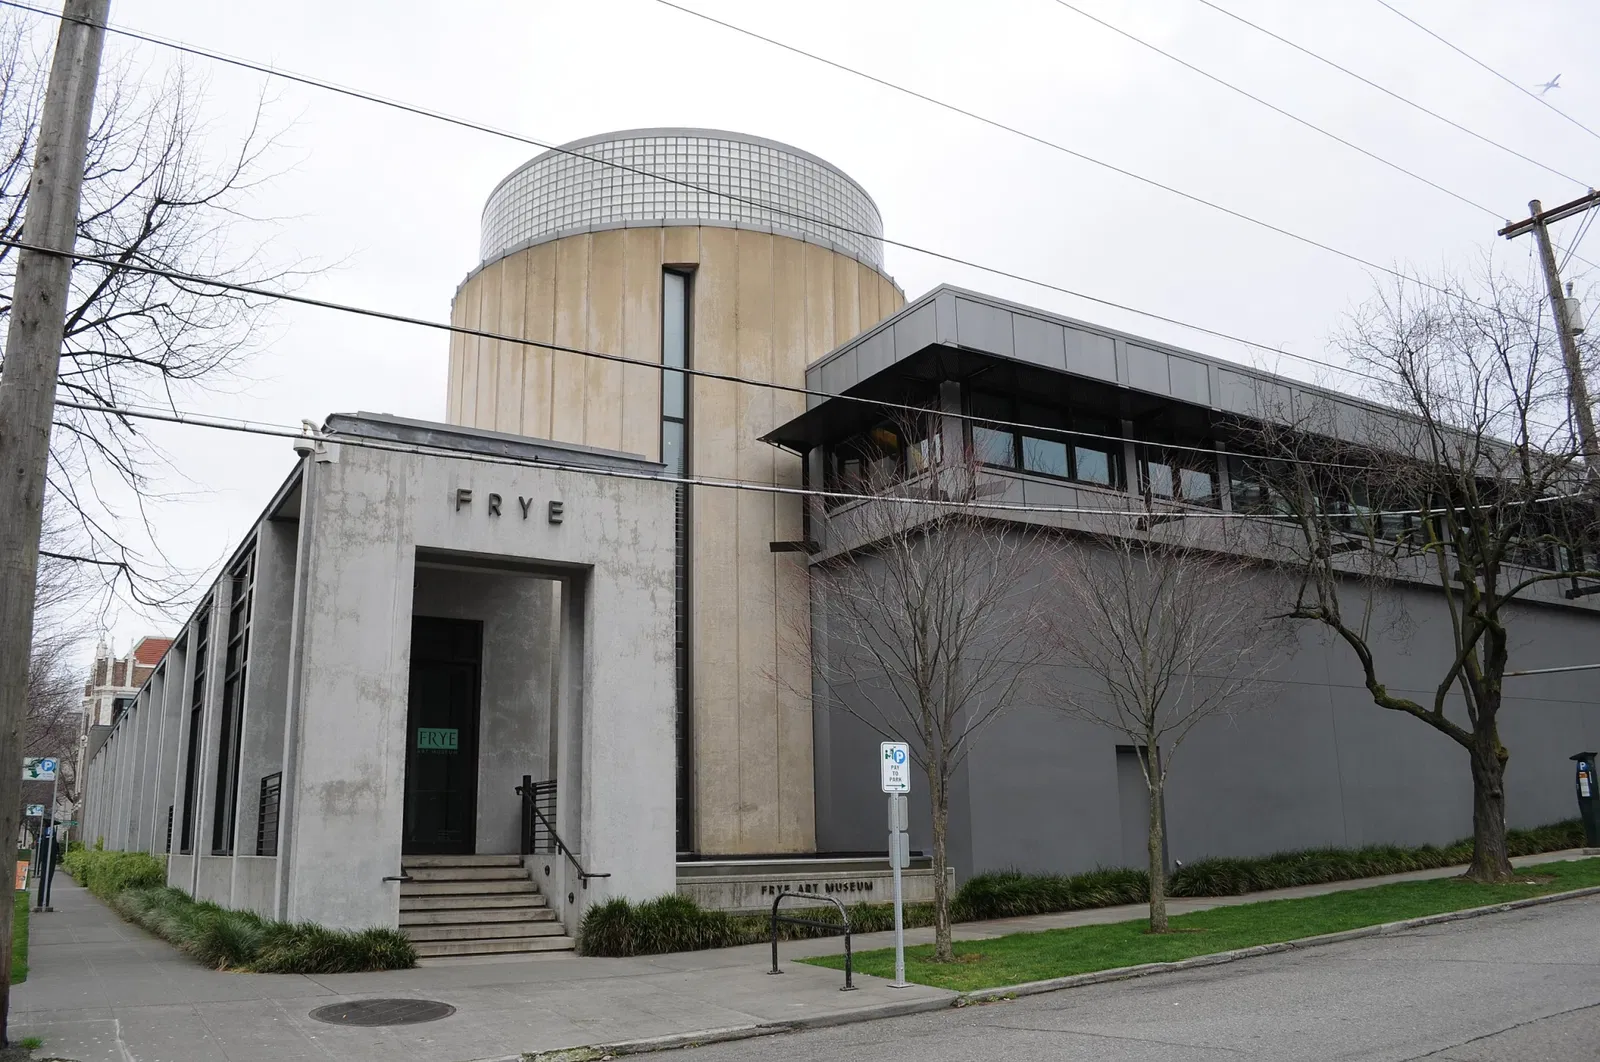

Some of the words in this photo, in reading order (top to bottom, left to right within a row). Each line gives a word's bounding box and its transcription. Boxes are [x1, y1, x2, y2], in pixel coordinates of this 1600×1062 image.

[456, 488, 563, 524] FRYE
[420, 731, 456, 746] FRYE
[761, 885, 790, 895] FRYE
[798, 883, 819, 894] ART
[825, 881, 873, 893] MUSEUM
